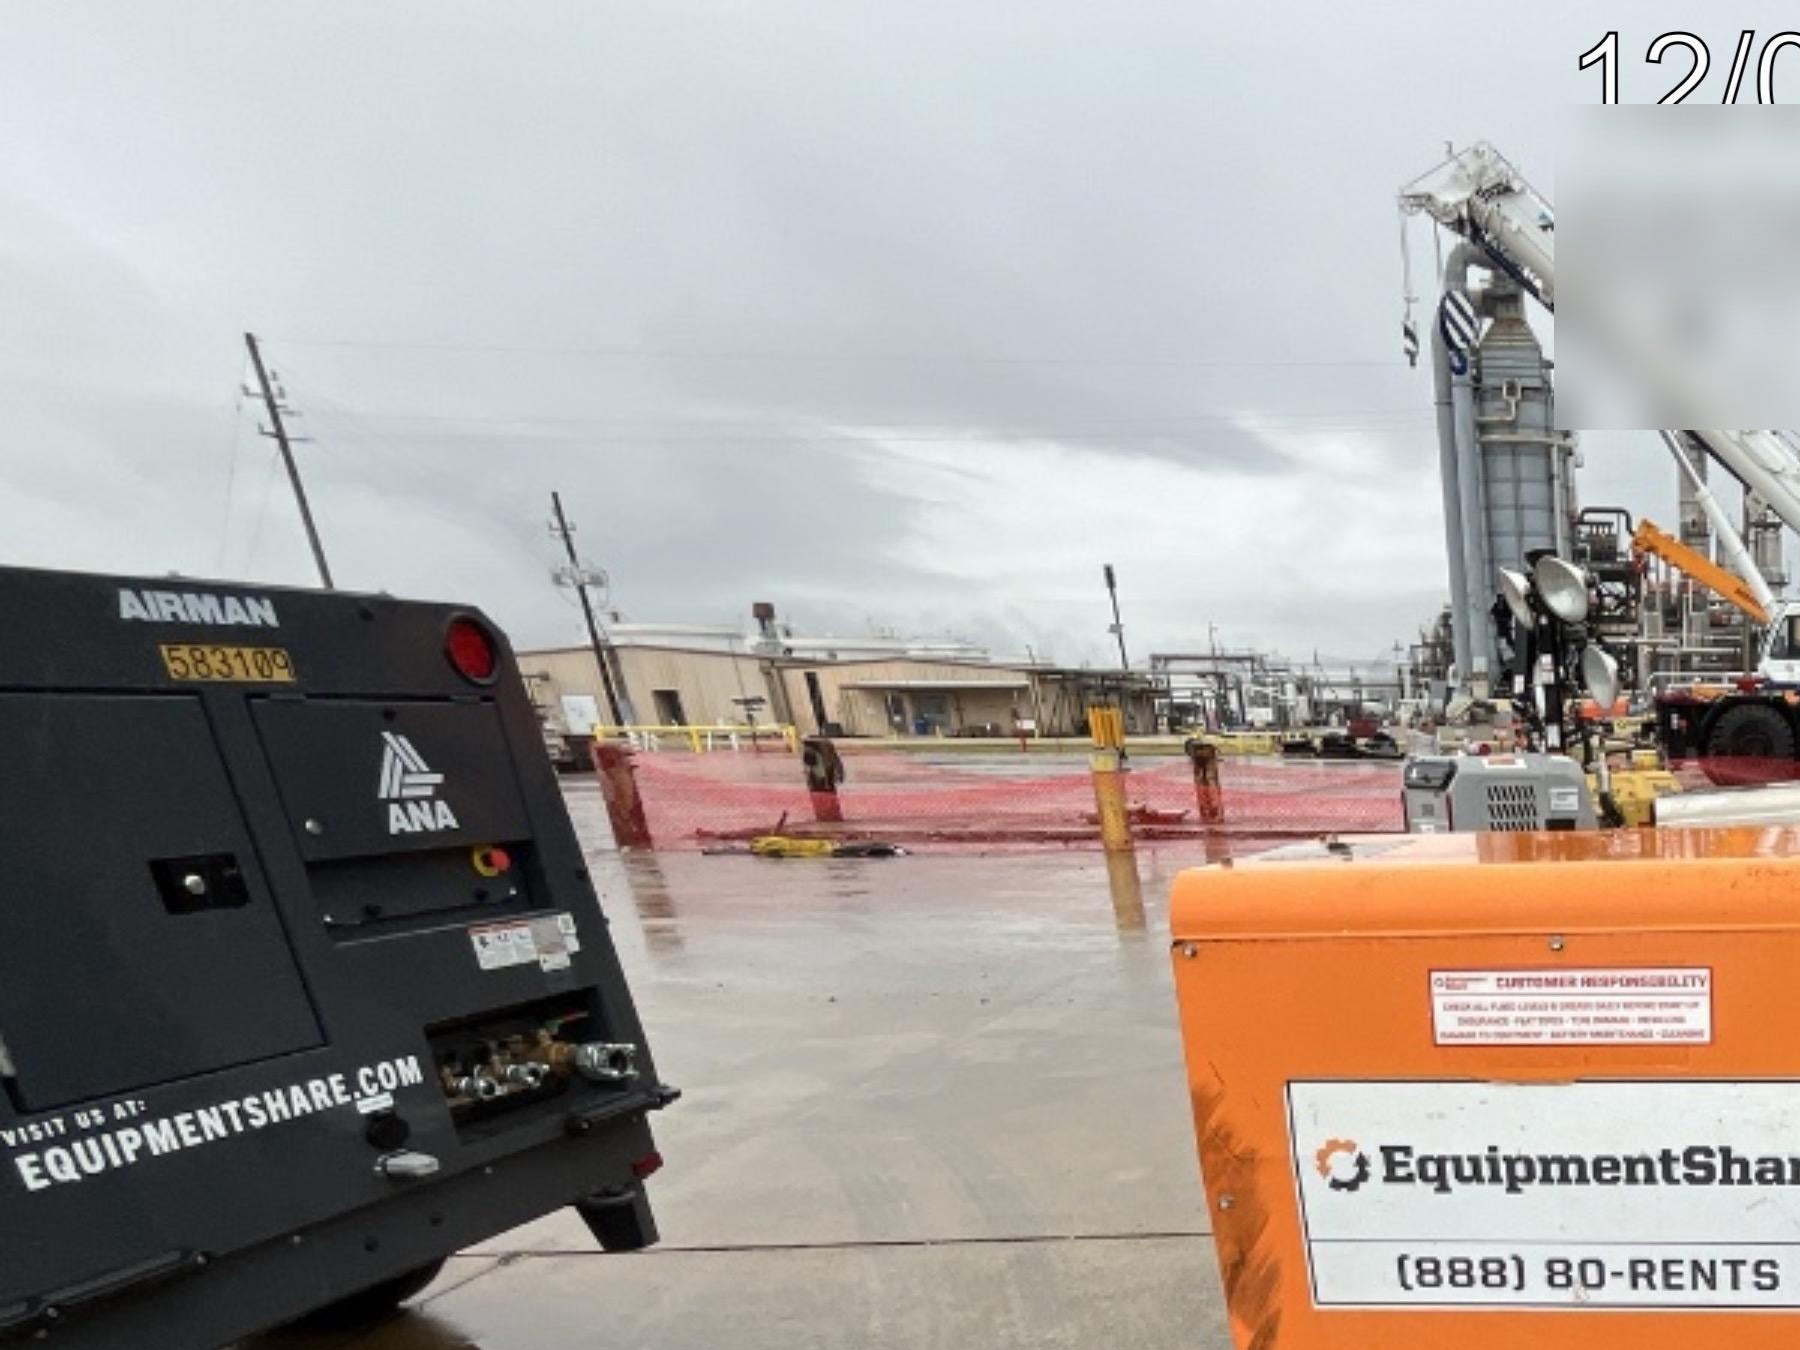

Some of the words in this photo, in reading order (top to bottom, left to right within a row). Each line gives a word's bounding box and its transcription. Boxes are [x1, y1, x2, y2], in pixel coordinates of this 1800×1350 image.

[118, 588, 280, 627] AIRMAN
[166, 647, 295, 679] 583109
[389, 800, 460, 834] ANA
[1496, 976, 1577, 989] CUSTOMER
[1580, 975, 1707, 988] RESPONSIBILITY
[1, 1117, 67, 1148] VISIT
[75, 1107, 106, 1130] US
[113, 1099, 147, 1121] AT:
[15, 1054, 424, 1192] EQUIPMENTSHARE.COM
[1397, 1252, 1525, 1291] (888)
[1546, 1257, 1781, 1292] 80-RENTS
